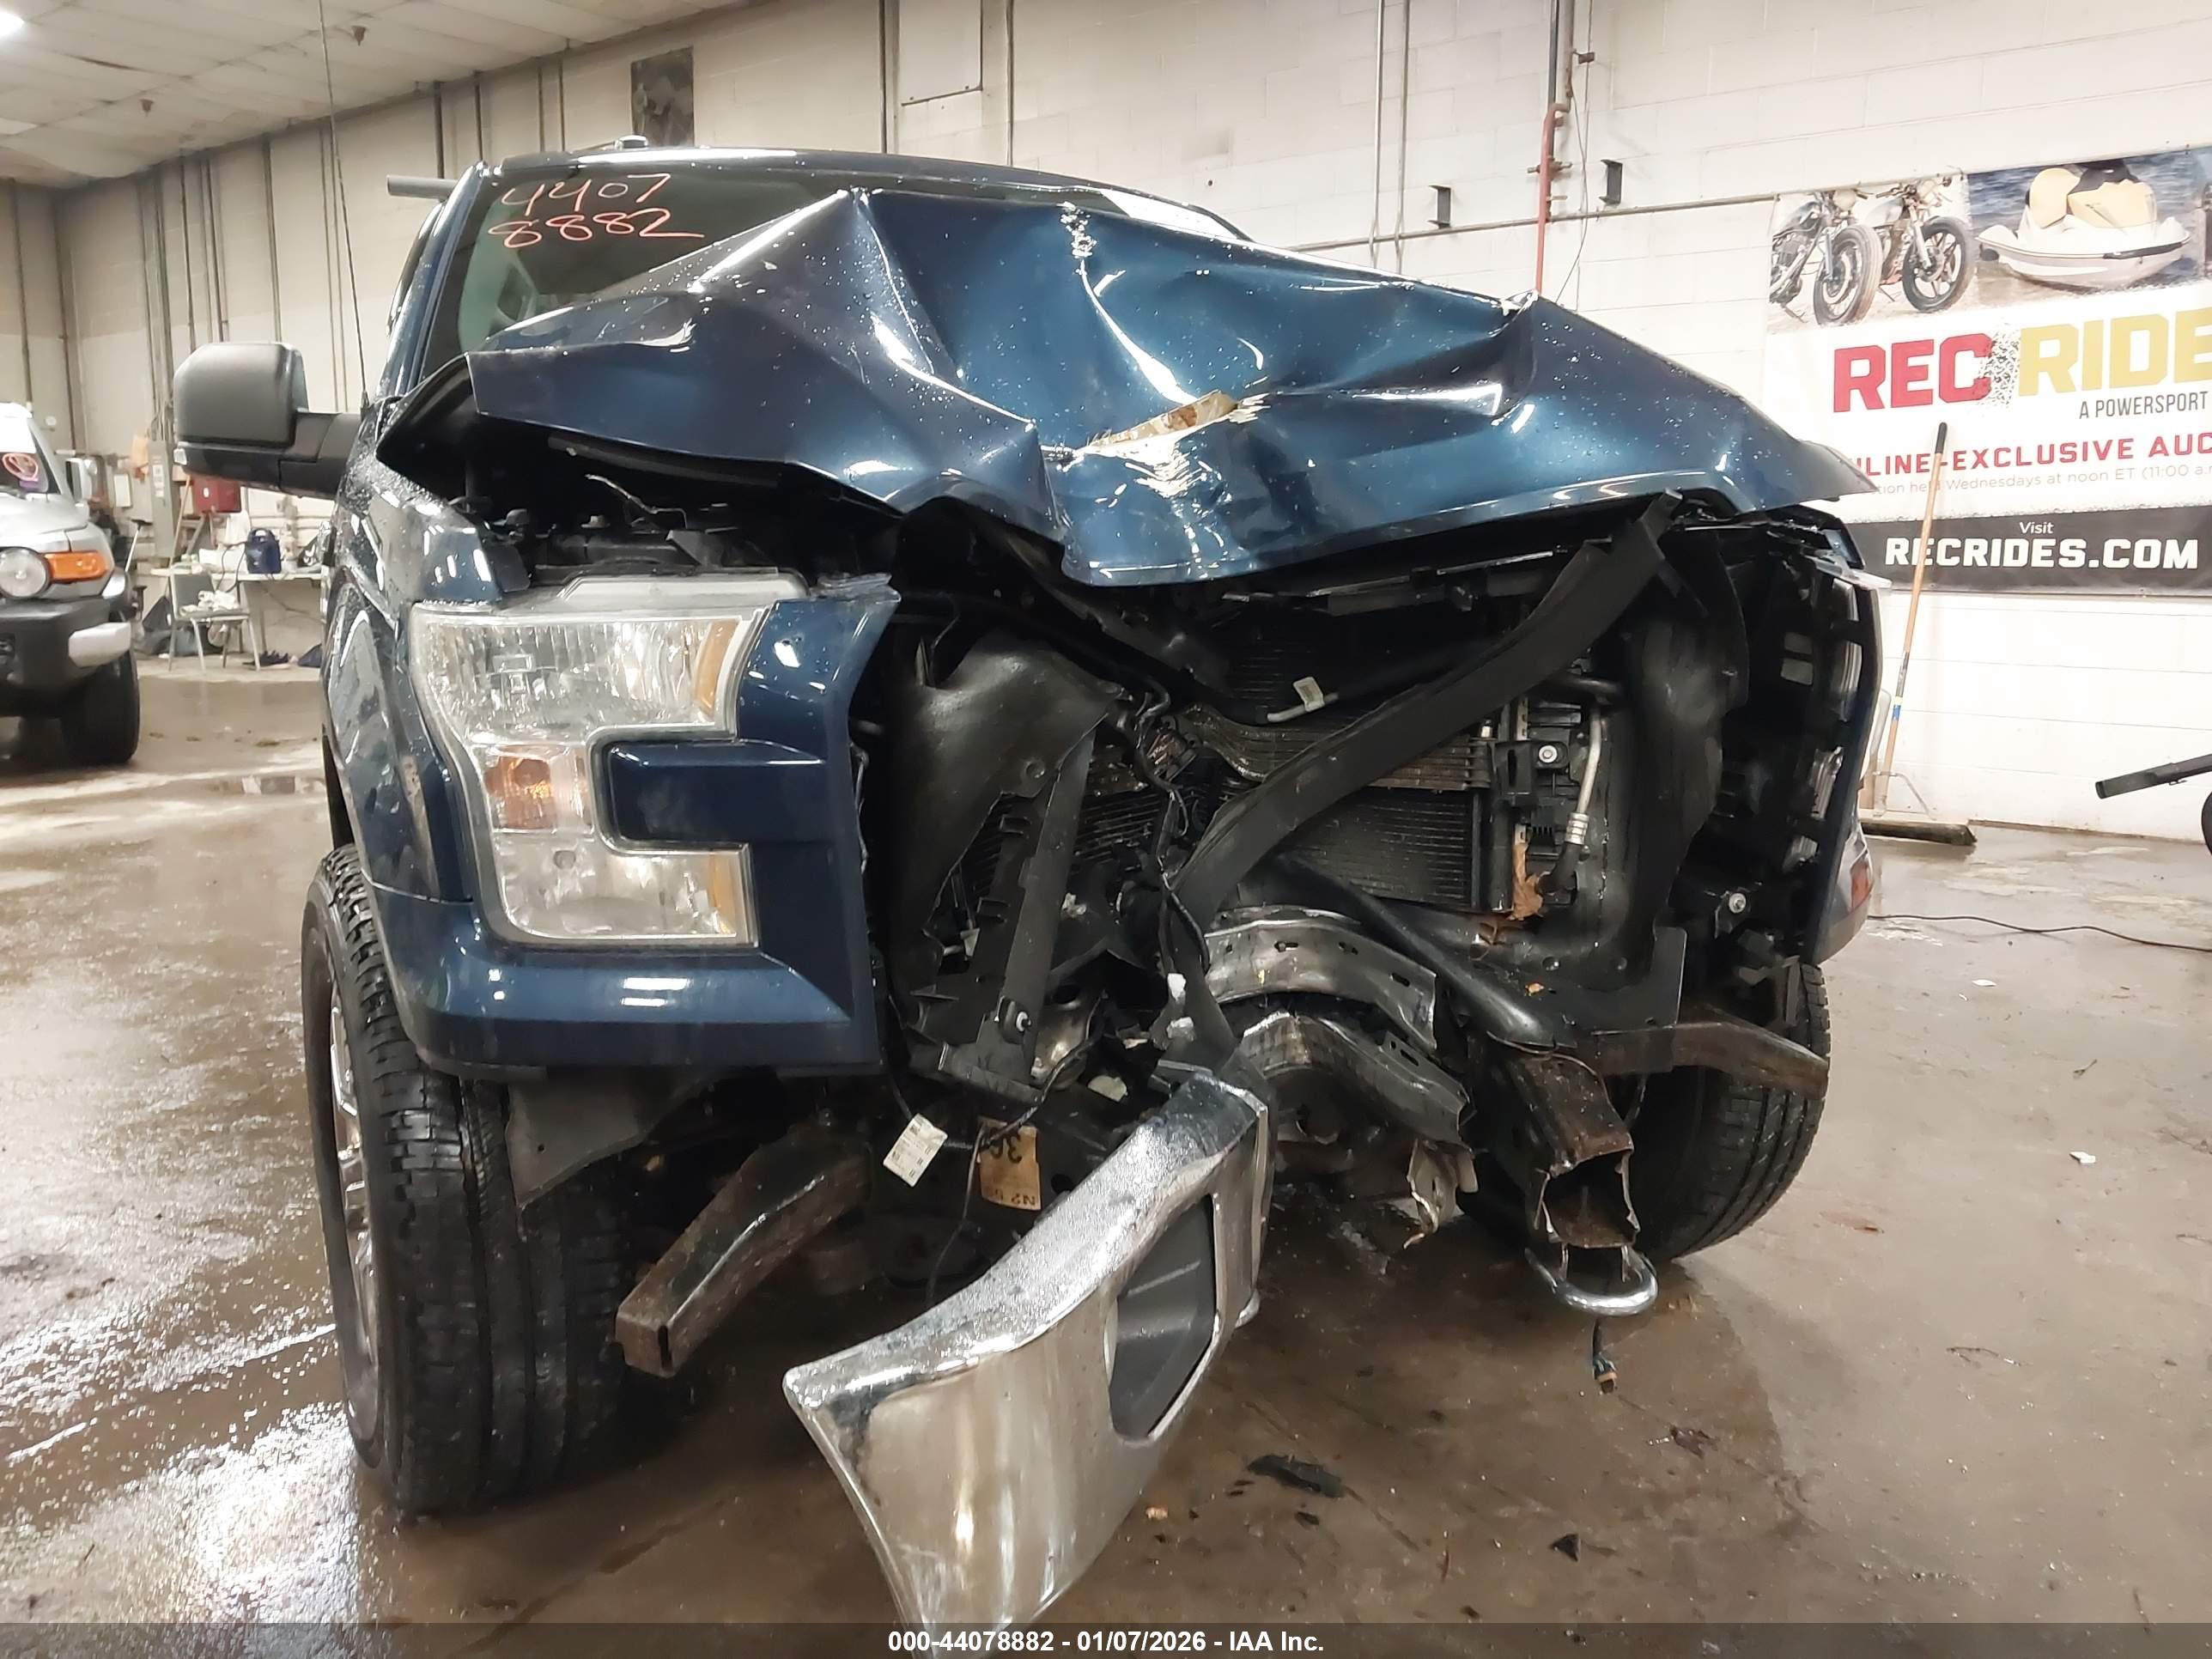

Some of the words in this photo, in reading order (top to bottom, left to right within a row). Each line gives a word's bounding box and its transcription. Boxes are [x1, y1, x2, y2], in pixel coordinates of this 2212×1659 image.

[501, 173, 671, 216] 4407
[488, 207, 705, 249] 8882
[1833, 332, 1993, 413] REC
[2018, 307, 2212, 397] RIDE
[2078, 401, 2089, 419] A
[2094, 391, 2209, 418] POWERSPORT
[1946, 473, 2042, 490] Wednesdays
[2046, 472, 2062, 484] at
[2068, 471, 2109, 483] noon
[2115, 467, 2136, 480] ET
[2142, 464, 2189, 478] (11:00
[2019, 521, 2055, 534] Visit
[1884, 538, 2198, 569] RECRIDES.COM
